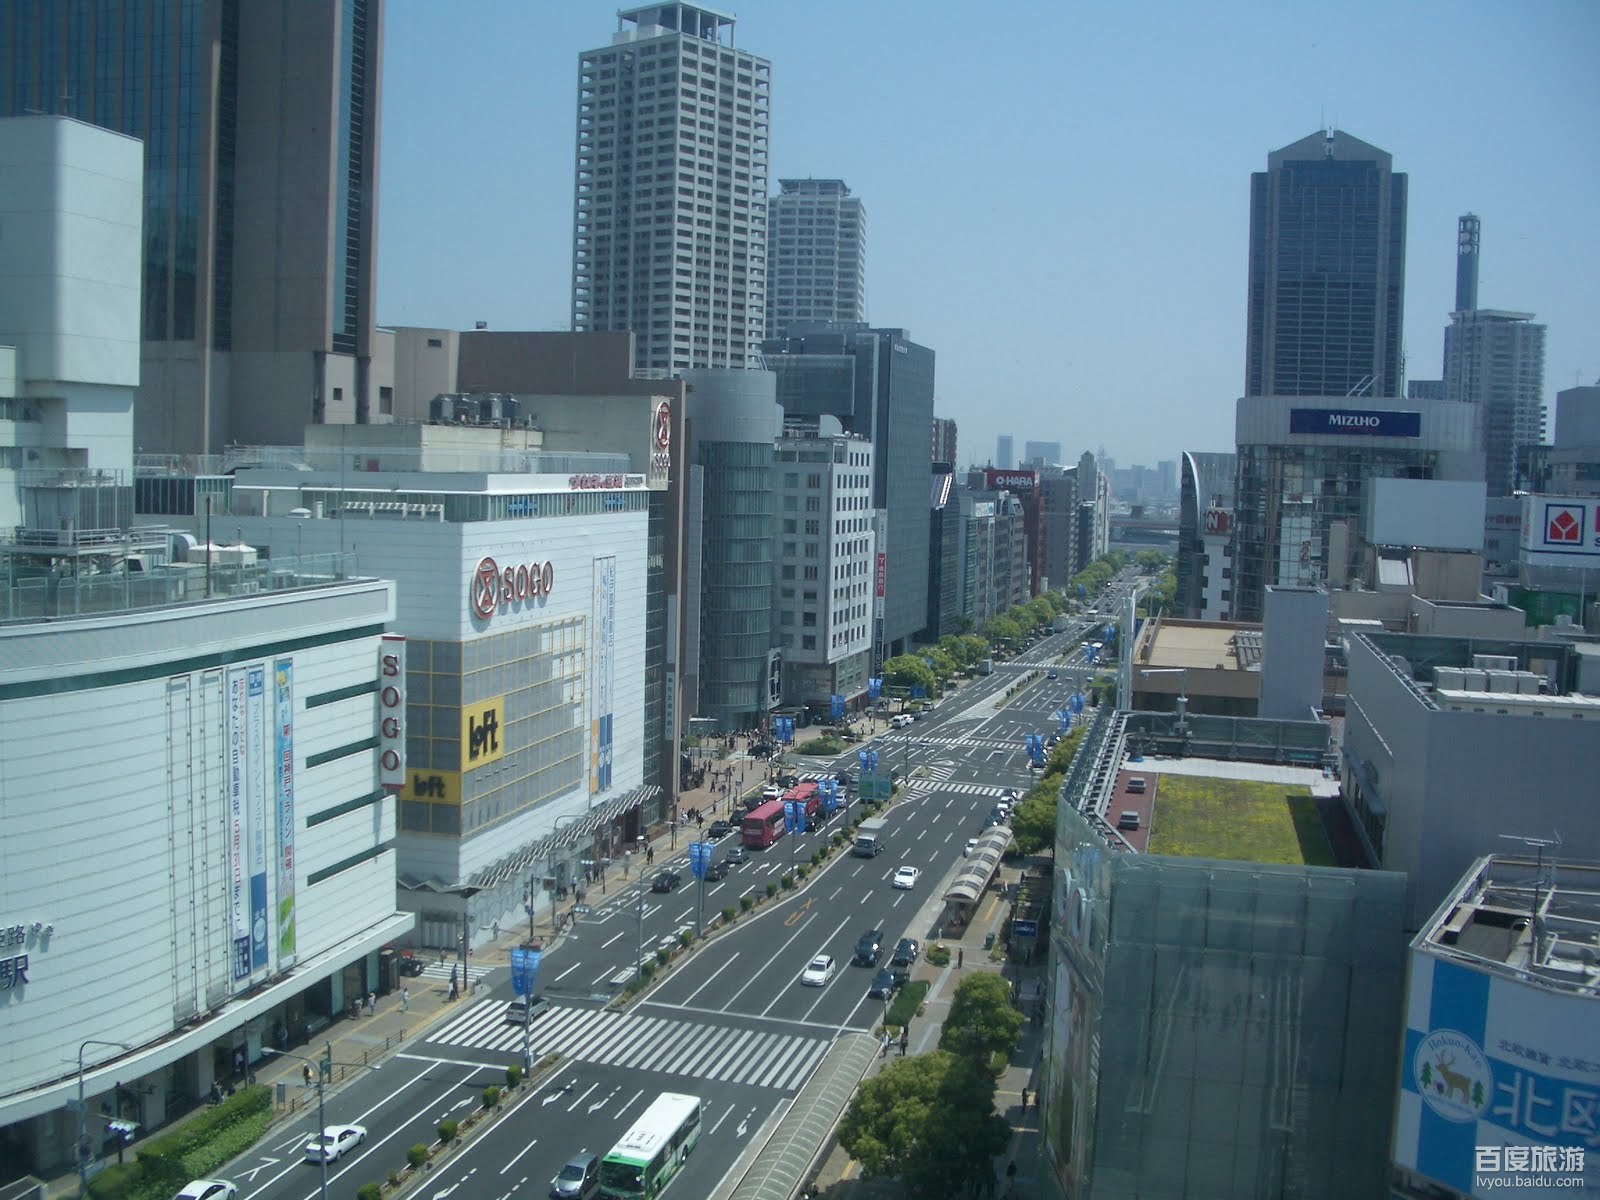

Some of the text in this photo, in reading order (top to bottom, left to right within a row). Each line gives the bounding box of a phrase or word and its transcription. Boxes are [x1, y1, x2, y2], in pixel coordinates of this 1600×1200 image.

[1329, 413, 1380, 428] MIZUHO
[502, 561, 554, 603] SOGO
[382, 655, 401, 771] SOGO
